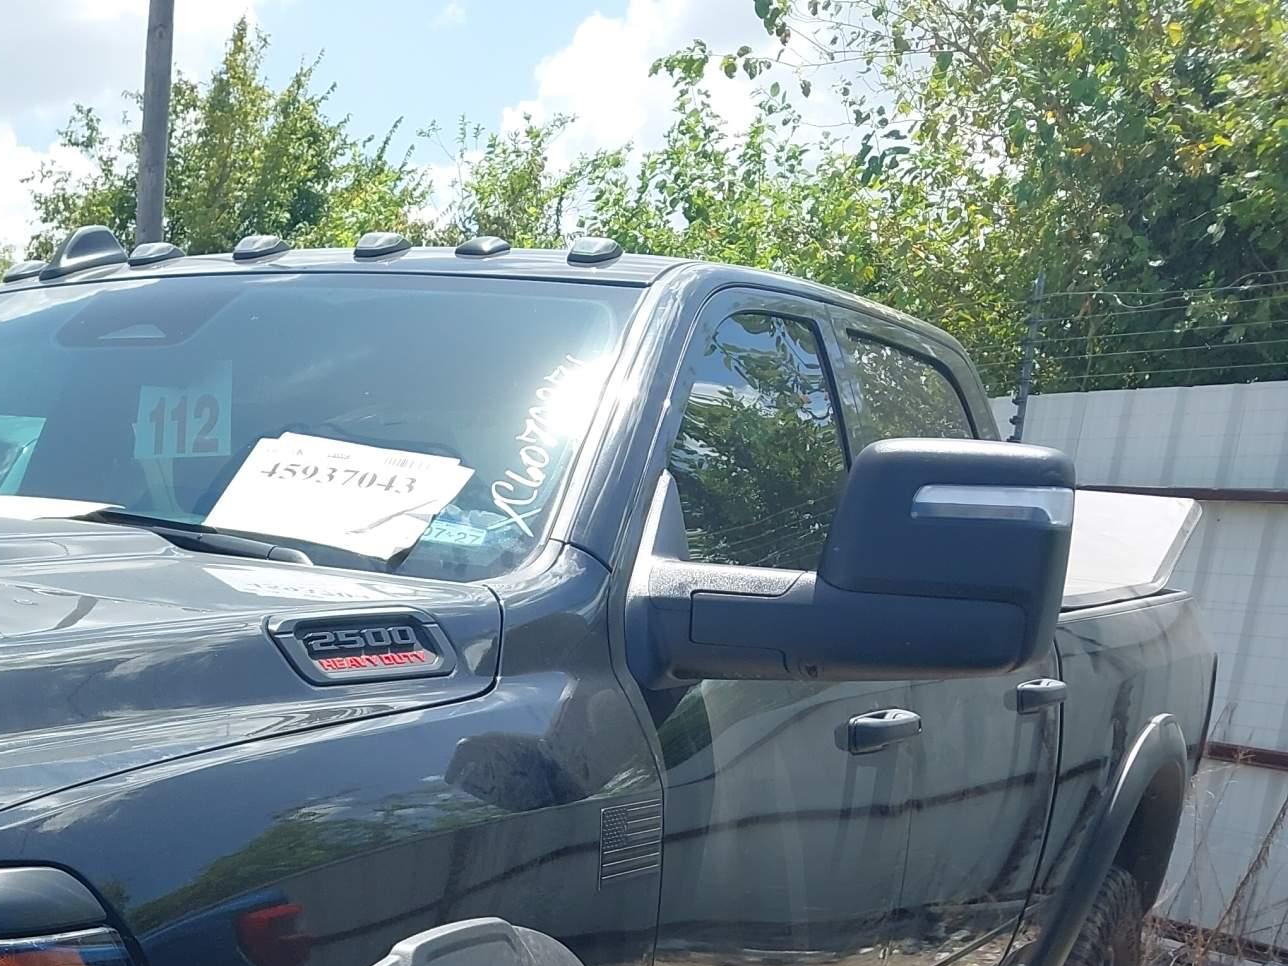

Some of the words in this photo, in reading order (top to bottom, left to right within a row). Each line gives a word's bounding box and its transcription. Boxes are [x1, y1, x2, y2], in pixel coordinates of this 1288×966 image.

[149, 393, 219, 455] 112
[260, 462, 417, 494] 45937043
[308, 626, 416, 651] 2500
[318, 654, 378, 671] HEAVY
[378, 650, 425, 666] DUTY
